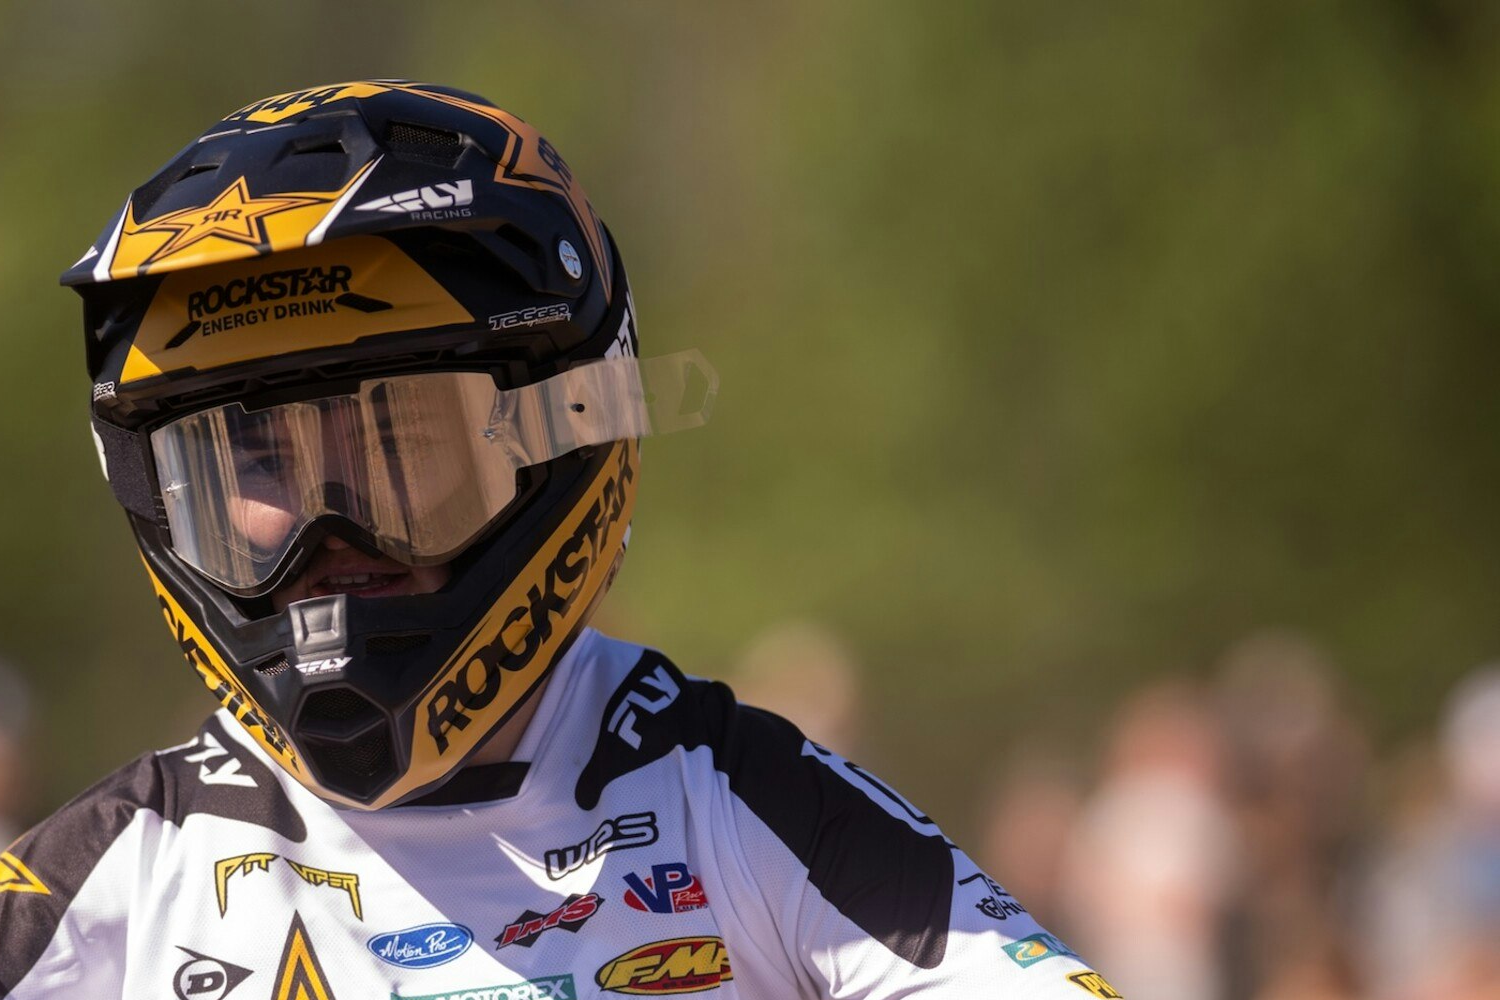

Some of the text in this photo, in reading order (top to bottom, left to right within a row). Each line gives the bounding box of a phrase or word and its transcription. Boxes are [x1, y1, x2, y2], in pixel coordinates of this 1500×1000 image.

[354, 179, 474, 213] FLY
[411, 207, 473, 221] RACING
[188, 265, 352, 321] ROCKSTAR
[202, 298, 336, 337] ENERGY DRINK
[426, 440, 635, 756] ROCKSTAR
[295, 656, 353, 674] FLY
[607, 664, 681, 750] FLY
[544, 811, 659, 881] WPS
[215, 852, 363, 922] PIT VIPER
[622, 863, 694, 914] VP
[379, 930, 460, 960] Motion Pro
[501, 892, 600, 948] IMS
